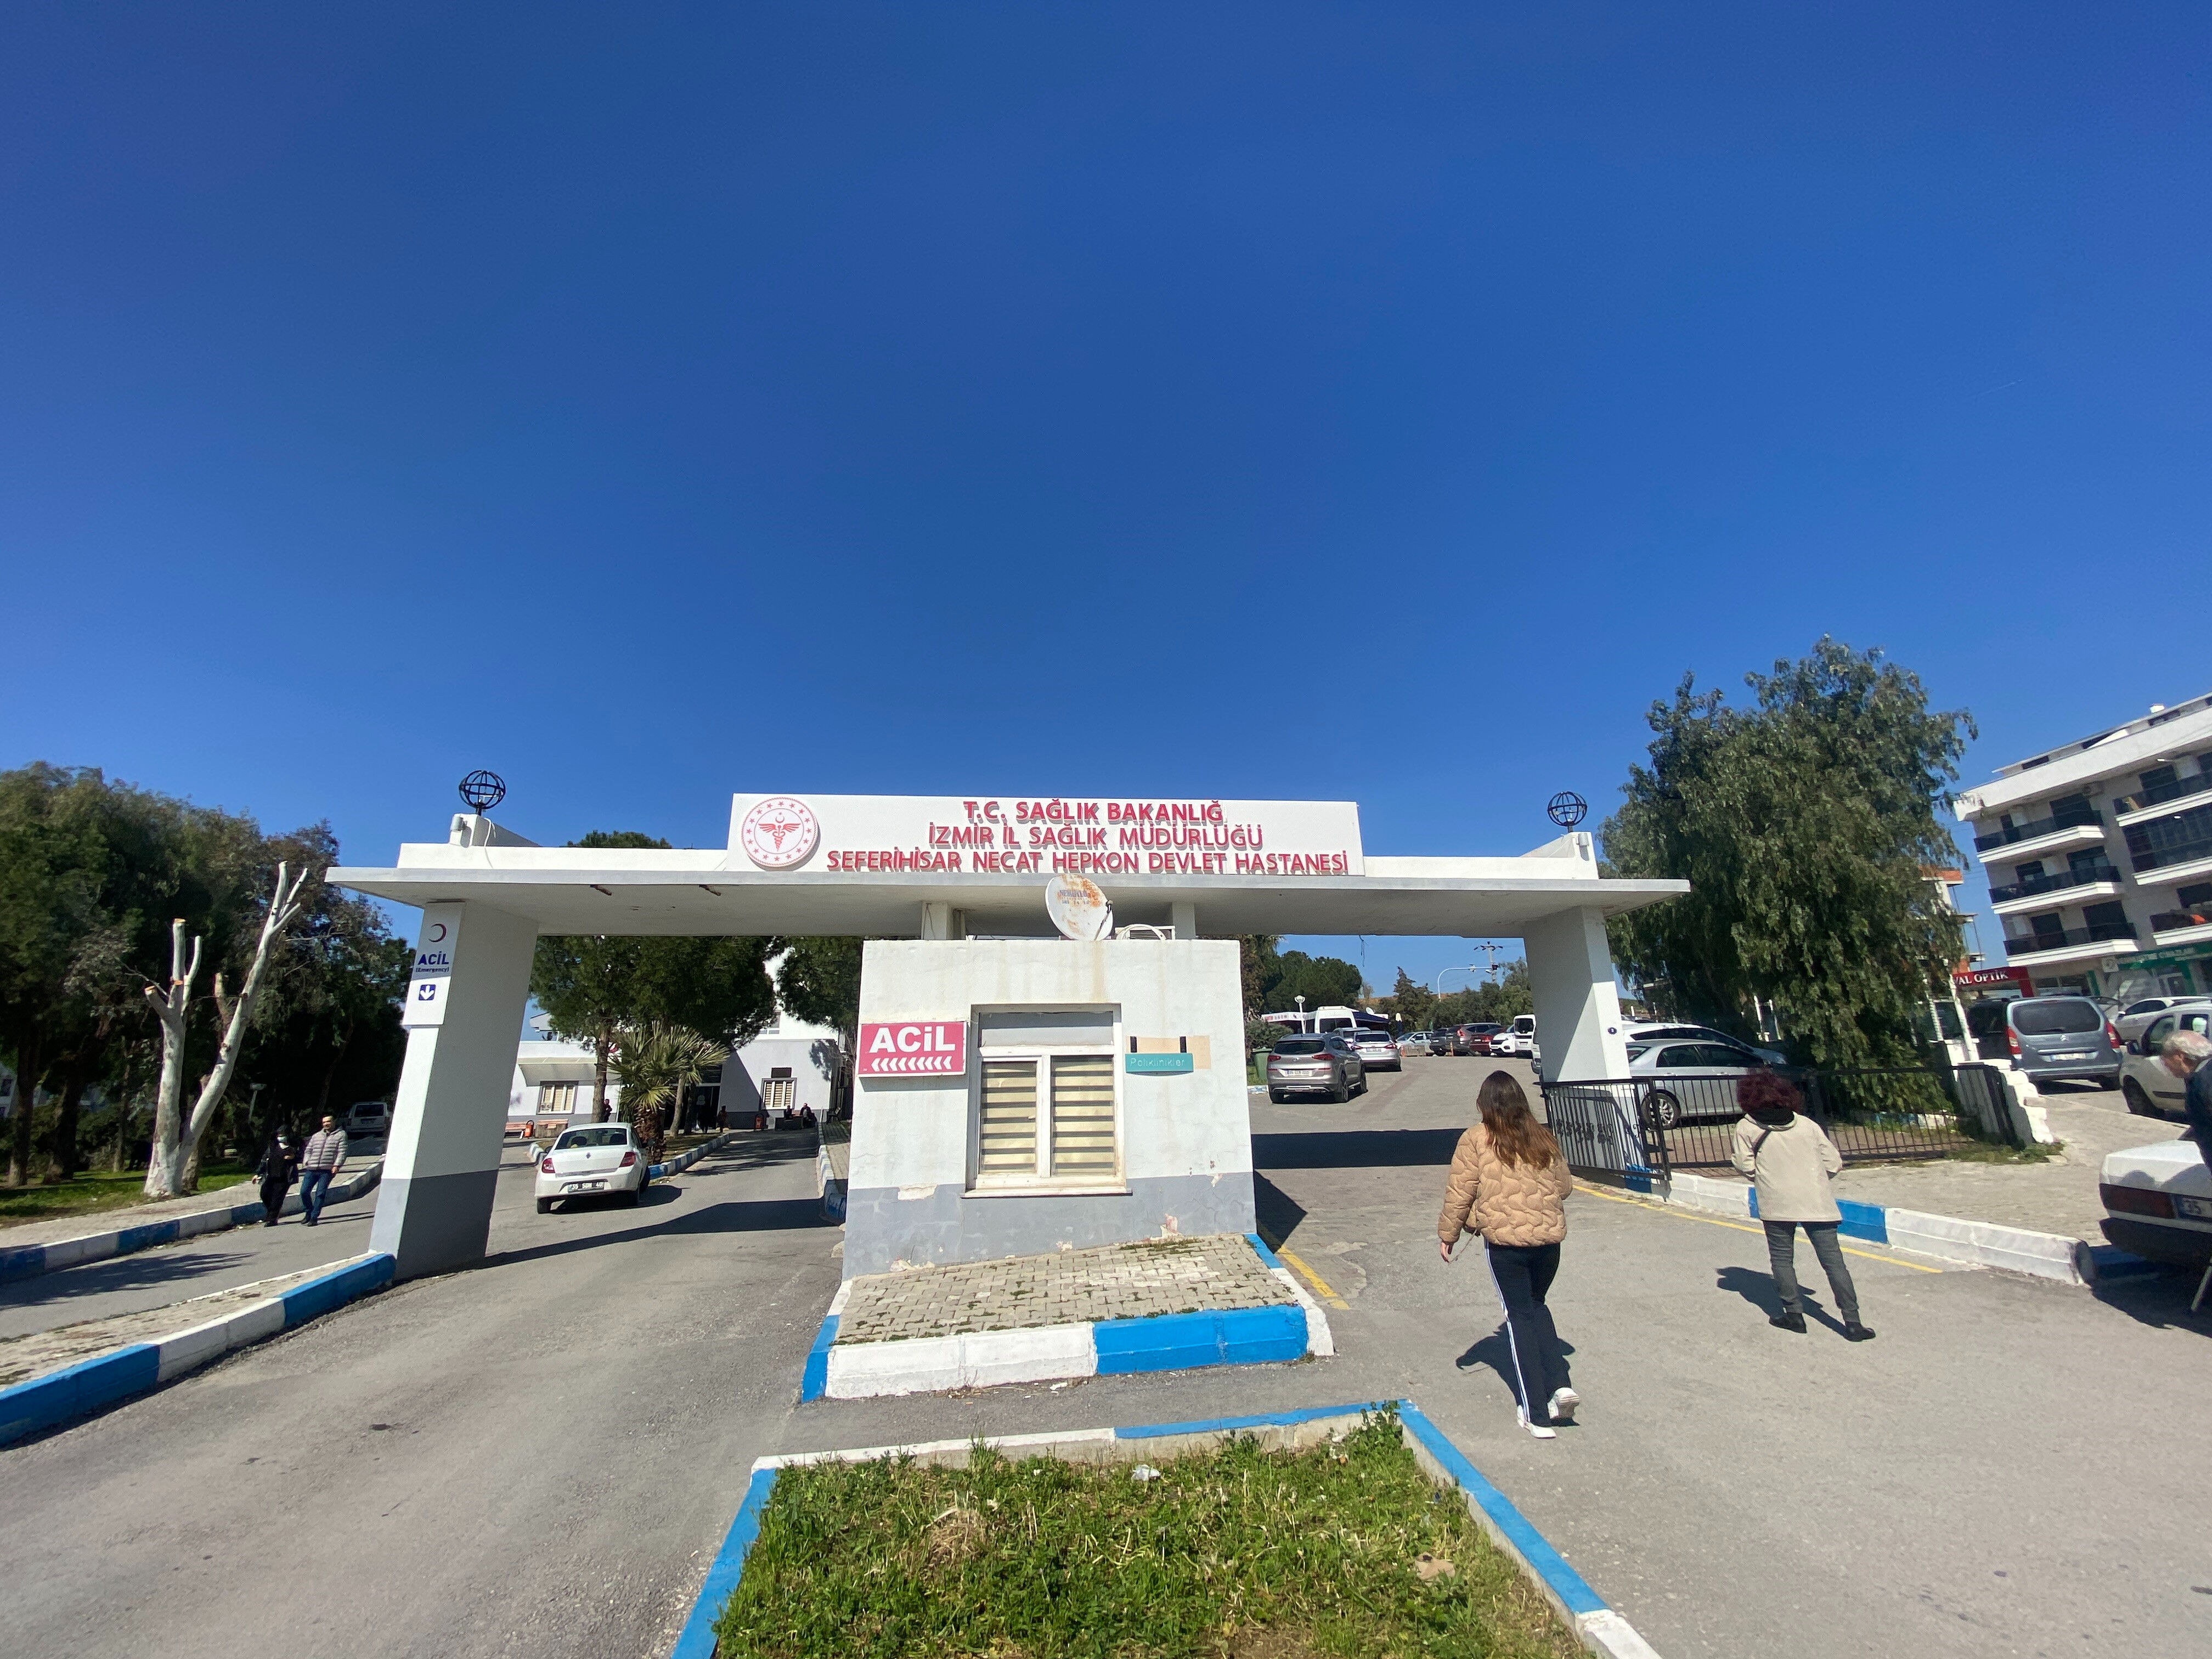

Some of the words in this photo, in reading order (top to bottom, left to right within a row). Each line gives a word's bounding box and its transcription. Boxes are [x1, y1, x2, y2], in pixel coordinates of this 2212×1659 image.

[963, 802, 1006, 819] T.C.
[1016, 799, 1098, 820] SAĞLIK
[929, 822, 994, 844] İZMİR
[1003, 822, 1019, 845] İL
[1029, 823, 1106, 846] SAĞLIK
[1119, 824, 1262, 847] MÜDÜRLÜĞÜ
[827, 847, 960, 870] SEFERİHİSAR
[973, 851, 1042, 870] NECAT
[1053, 853, 1139, 871] HEPKON
[1148, 853, 1227, 871] DEVLET
[1235, 850, 1348, 872] HASTANESİ
[417, 951, 449, 965] ACİL
[1974, 970, 2008, 983] OPTİK
